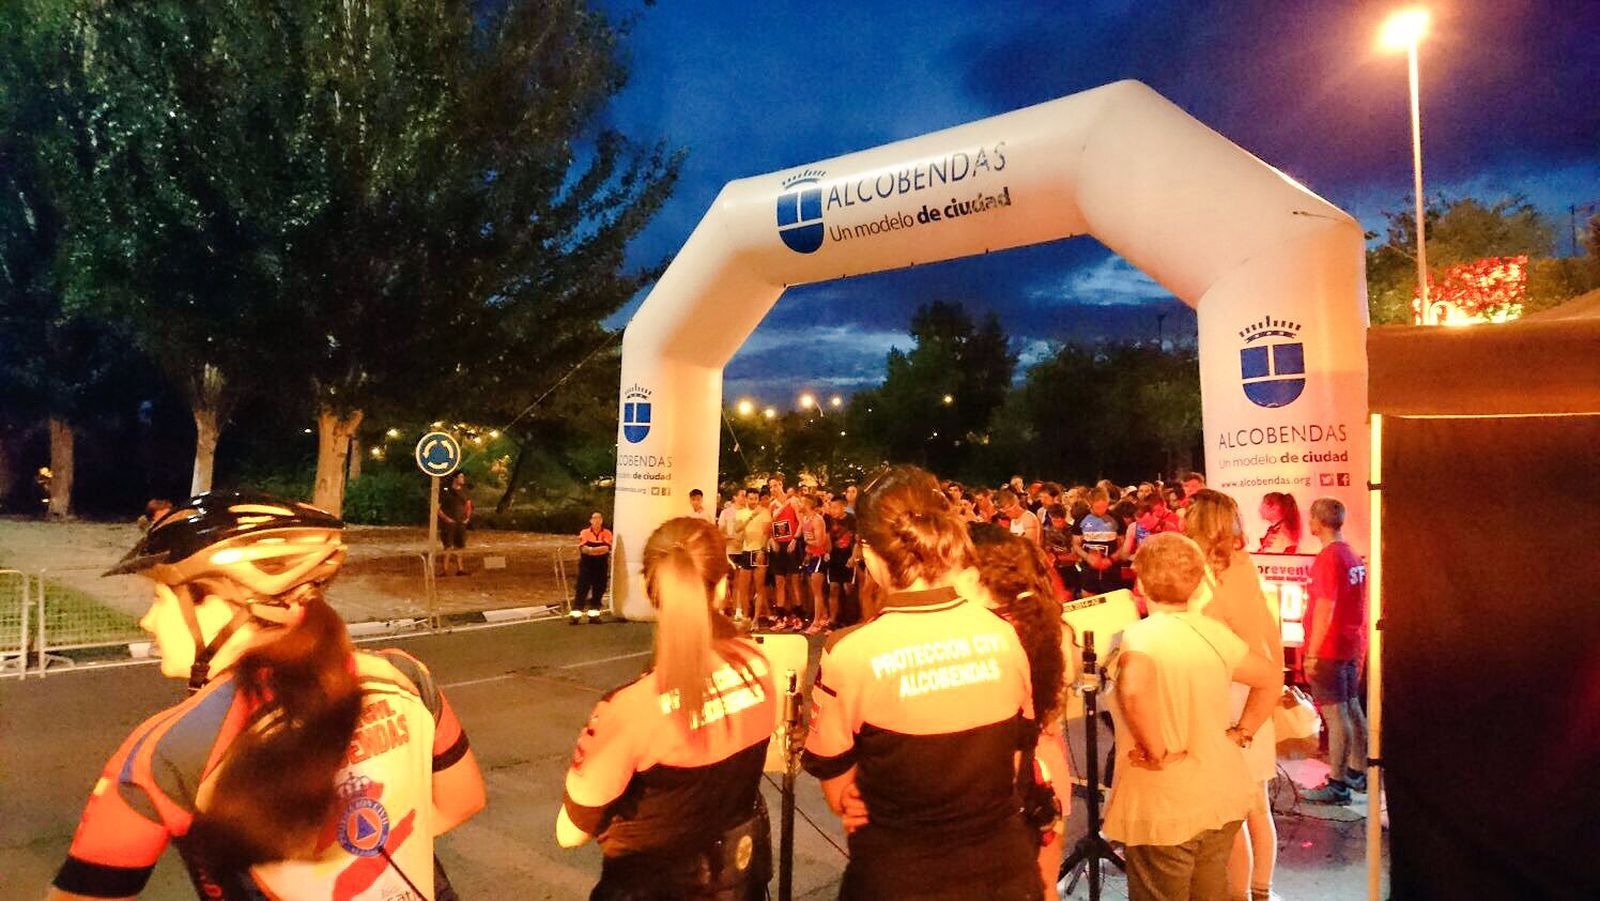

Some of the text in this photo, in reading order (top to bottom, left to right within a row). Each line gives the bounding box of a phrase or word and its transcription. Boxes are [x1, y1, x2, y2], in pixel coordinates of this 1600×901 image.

[826, 141, 1006, 211] ALCOBENDAS
[829, 186, 1011, 242] Un modelo de ciudad
[1218, 424, 1347, 449] ALCOBENDAS
[1233, 453, 1277, 467] modelo
[1280, 452, 1299, 463] de
[1302, 450, 1349, 463] ciudad
[643, 472, 671, 480] ciudad
[900, 658, 1001, 698] ALCOBENDAS
